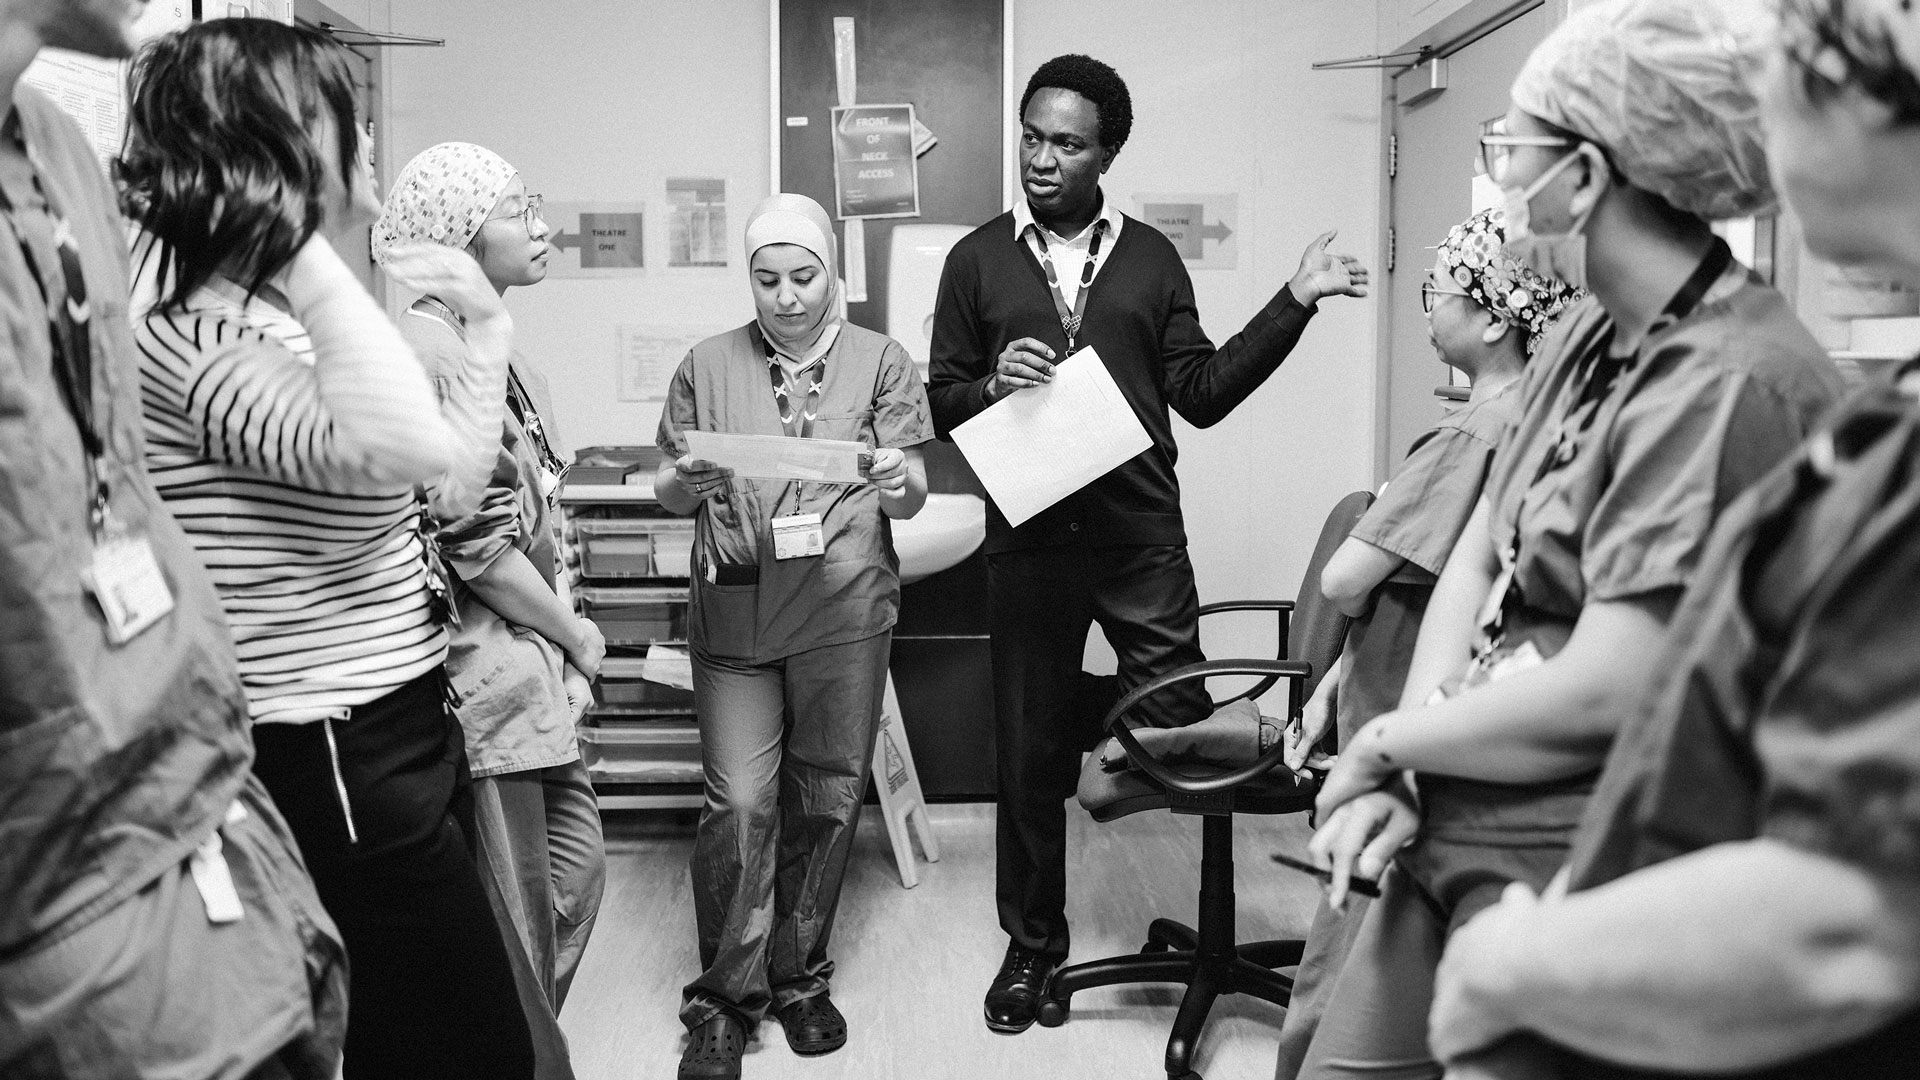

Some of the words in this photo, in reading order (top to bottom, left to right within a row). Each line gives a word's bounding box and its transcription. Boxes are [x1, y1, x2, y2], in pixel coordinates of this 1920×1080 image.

[856, 116, 890, 128] FRONT
[866, 134, 881, 145] OF
[861, 151, 889, 162] NECK
[858, 168, 895, 179] ACCESS
[1156, 218, 1190, 226] THEATRE
[592, 229, 627, 237] THEATRE
[598, 243, 616, 251] ONE
